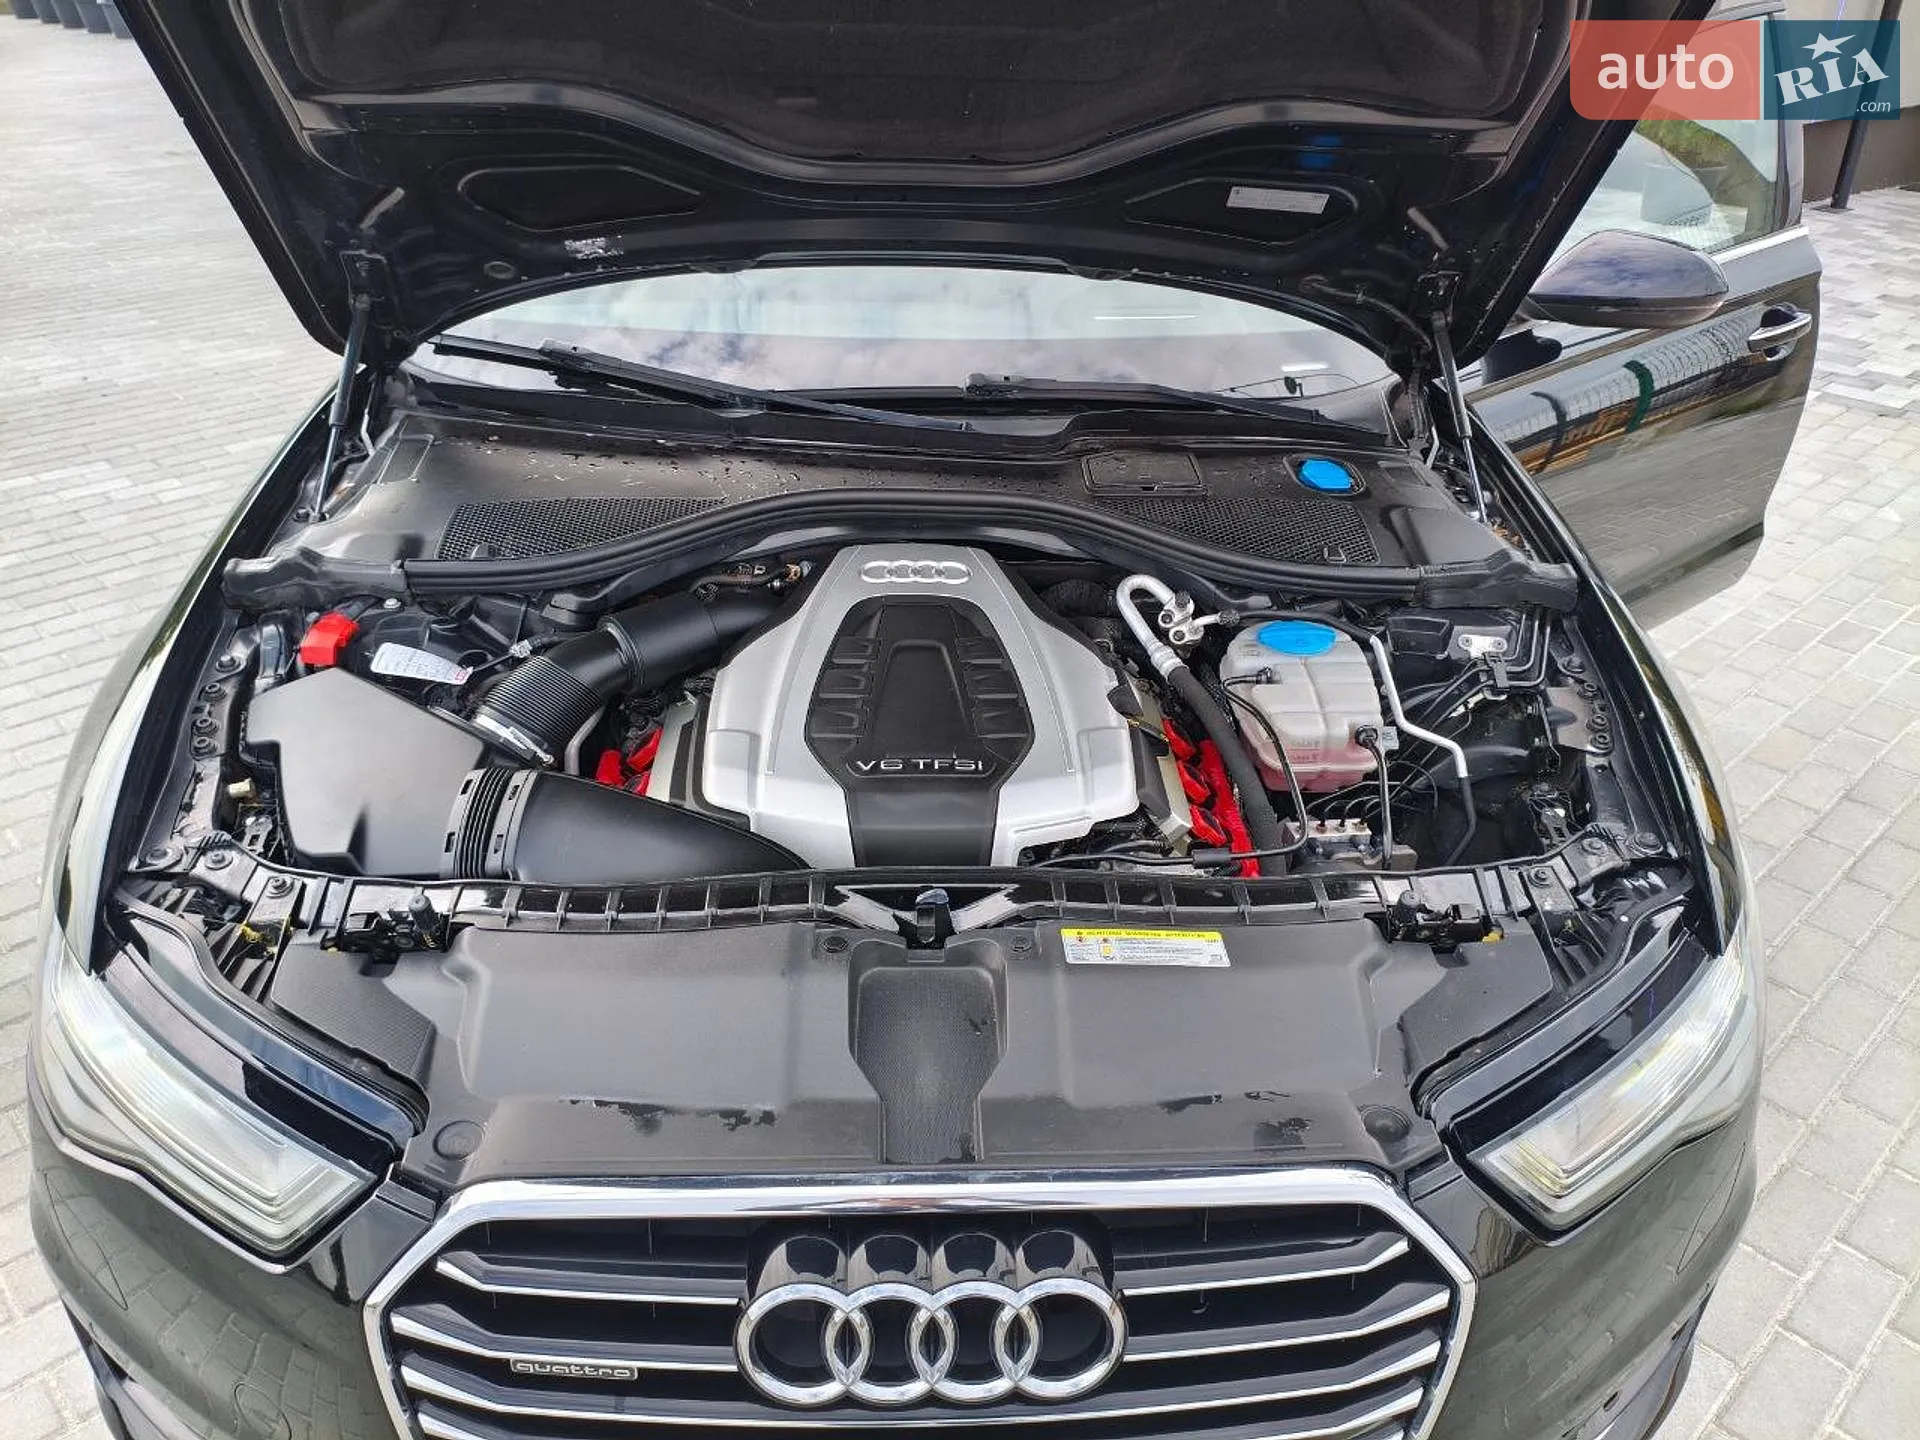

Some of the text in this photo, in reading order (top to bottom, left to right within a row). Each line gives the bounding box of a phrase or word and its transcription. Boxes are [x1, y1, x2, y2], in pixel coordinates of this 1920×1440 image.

[856, 759, 984, 771] V6 TFSI
[516, 1362, 631, 1377] quattro
